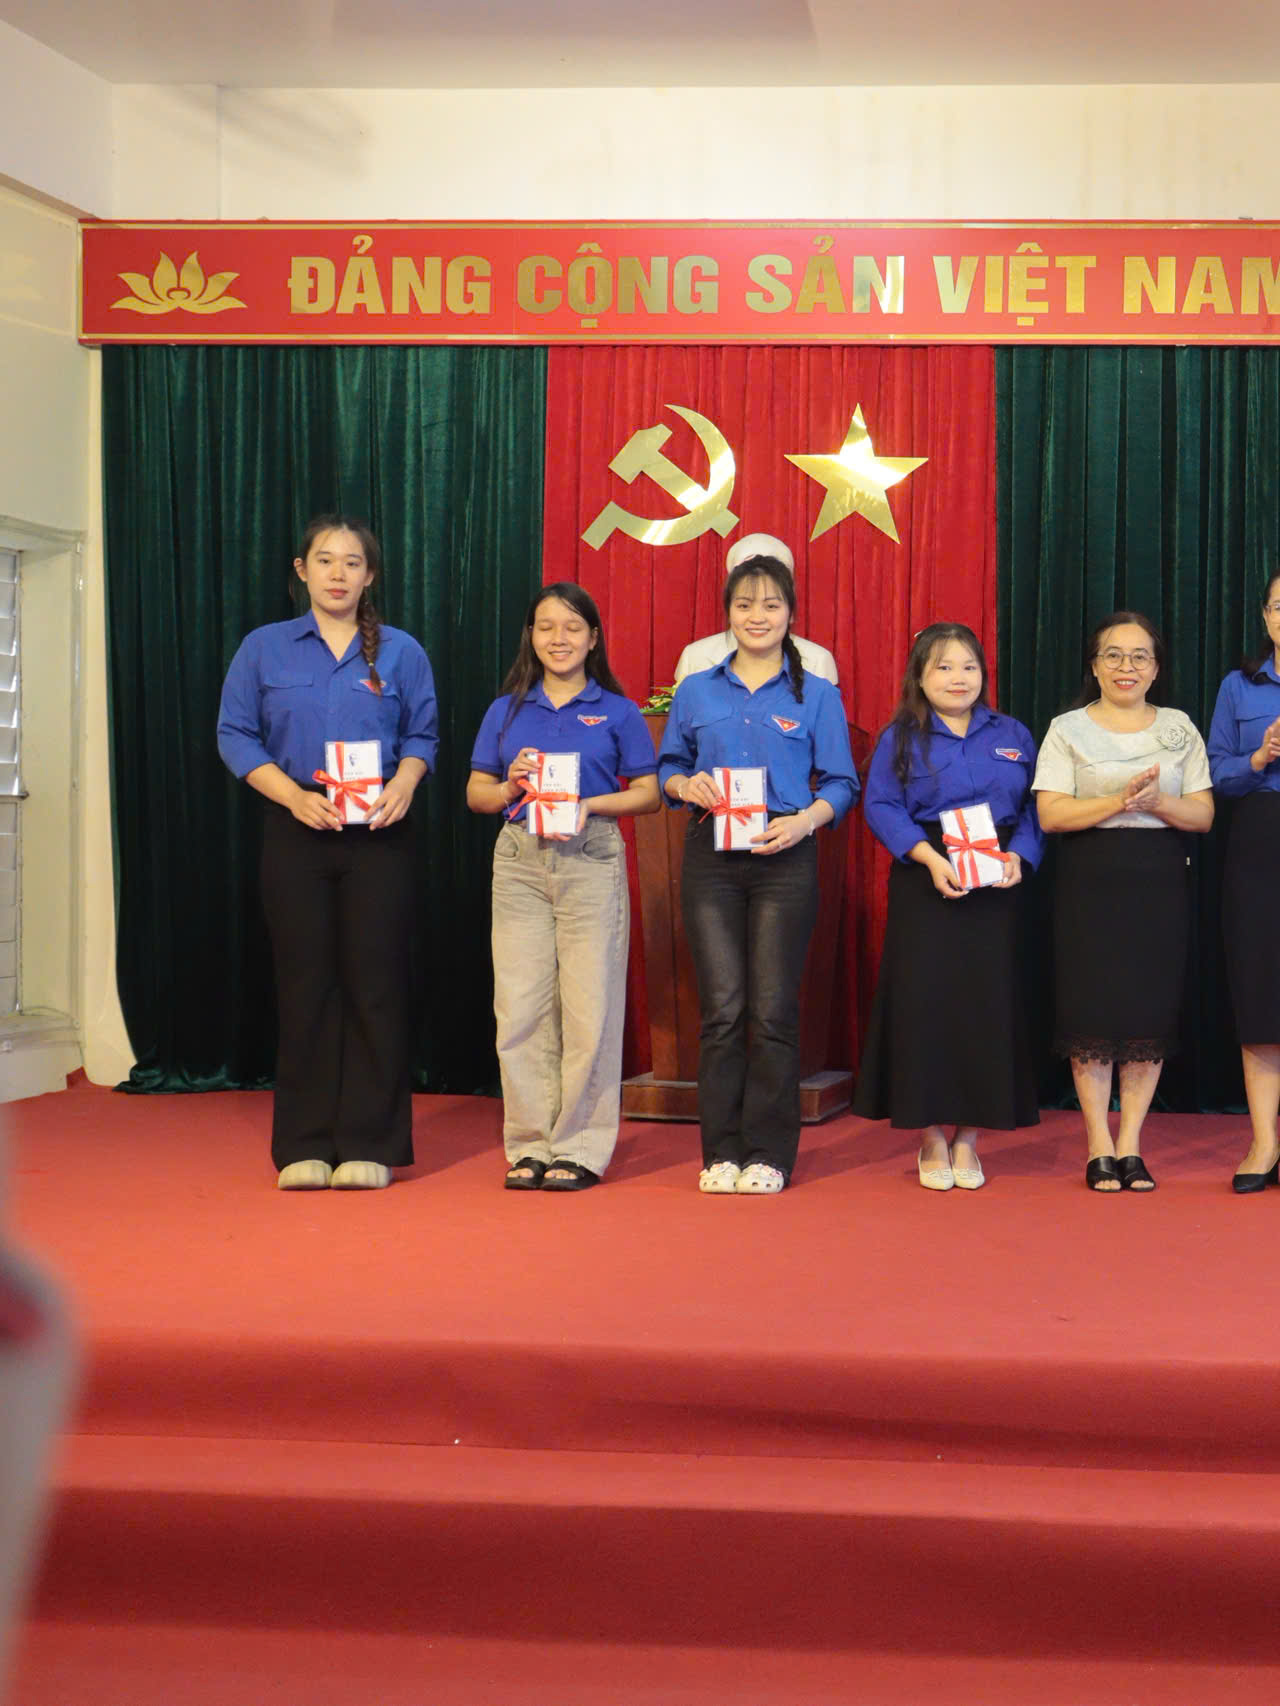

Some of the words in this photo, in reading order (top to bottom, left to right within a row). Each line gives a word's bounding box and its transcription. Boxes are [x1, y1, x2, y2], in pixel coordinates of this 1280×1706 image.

[288, 235, 491, 315] ĐẢNG
[517, 242, 719, 328] CỘNG
[745, 233, 905, 315] SẢN
[933, 242, 1096, 326] VIỆT
